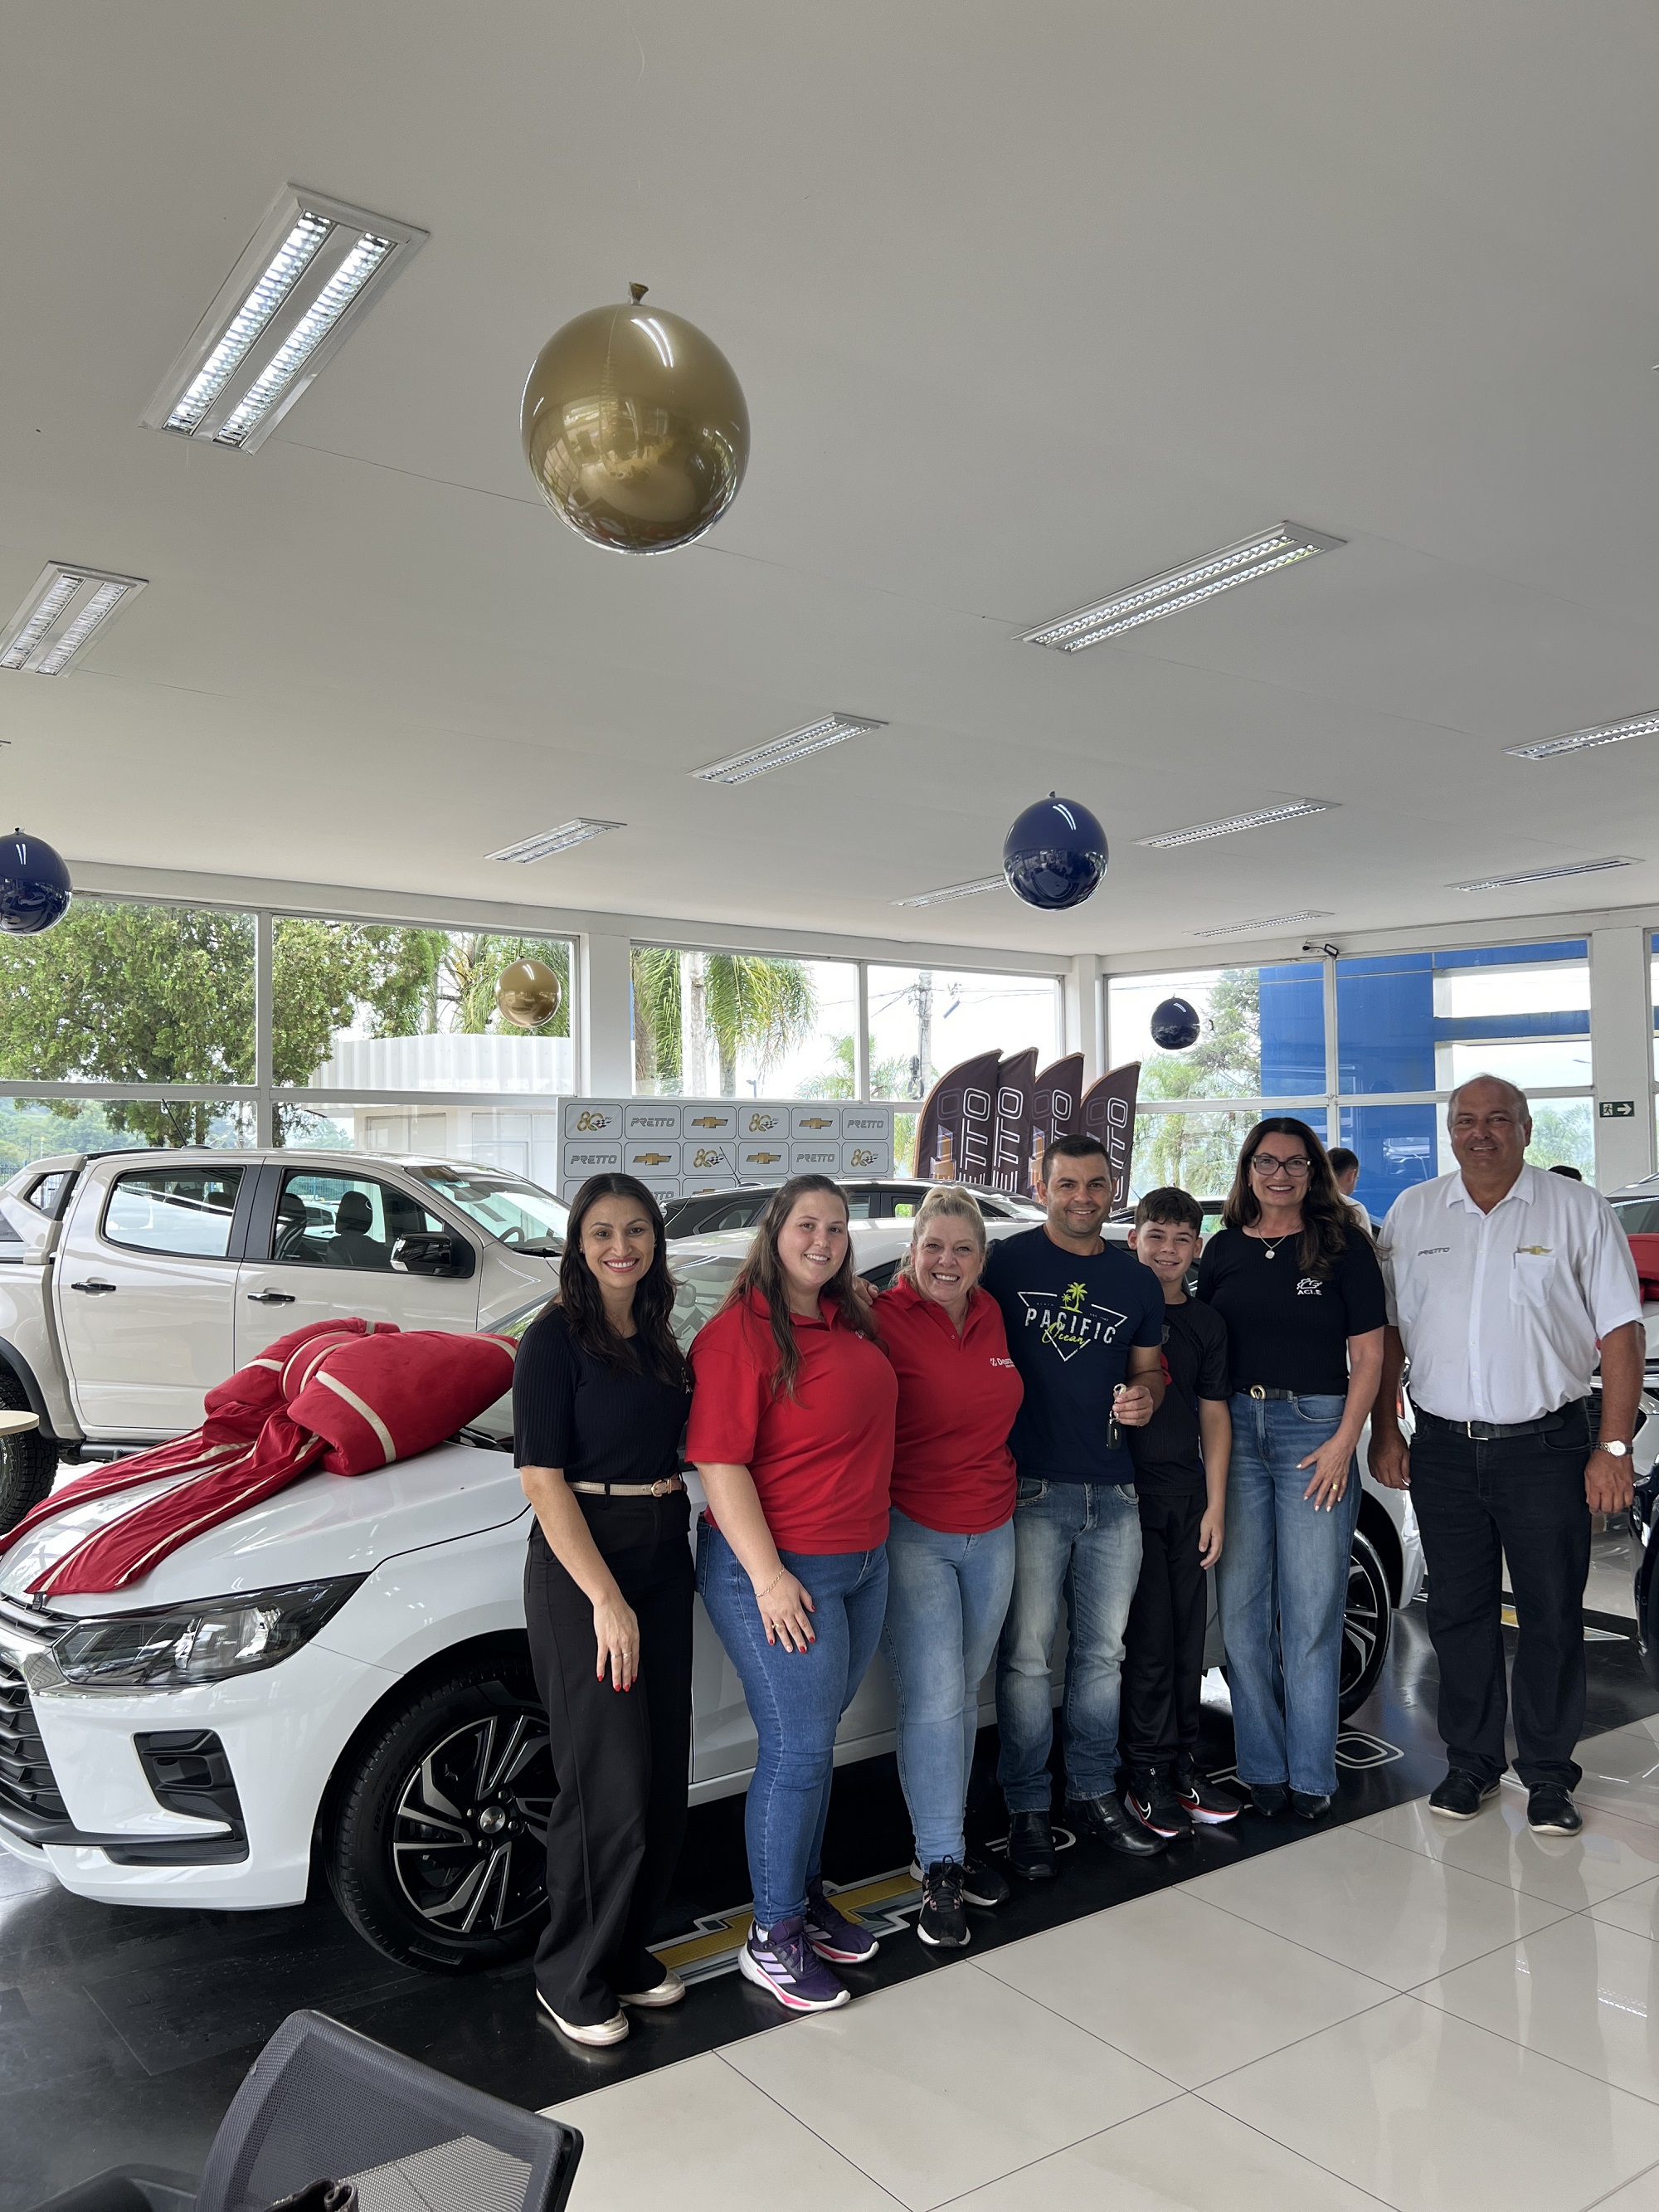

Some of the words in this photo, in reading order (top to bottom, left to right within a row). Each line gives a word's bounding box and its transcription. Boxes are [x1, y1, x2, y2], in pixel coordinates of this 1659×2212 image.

[630, 1118, 675, 1128] PRETTO
[847, 1120, 884, 1129] PRETTO
[570, 1155, 618, 1164] PRETTO
[796, 1153, 835, 1162] PRETTO
[1024, 1308, 1117, 1344] PACIFIC
[1041, 1321, 1085, 1345] Ocean
